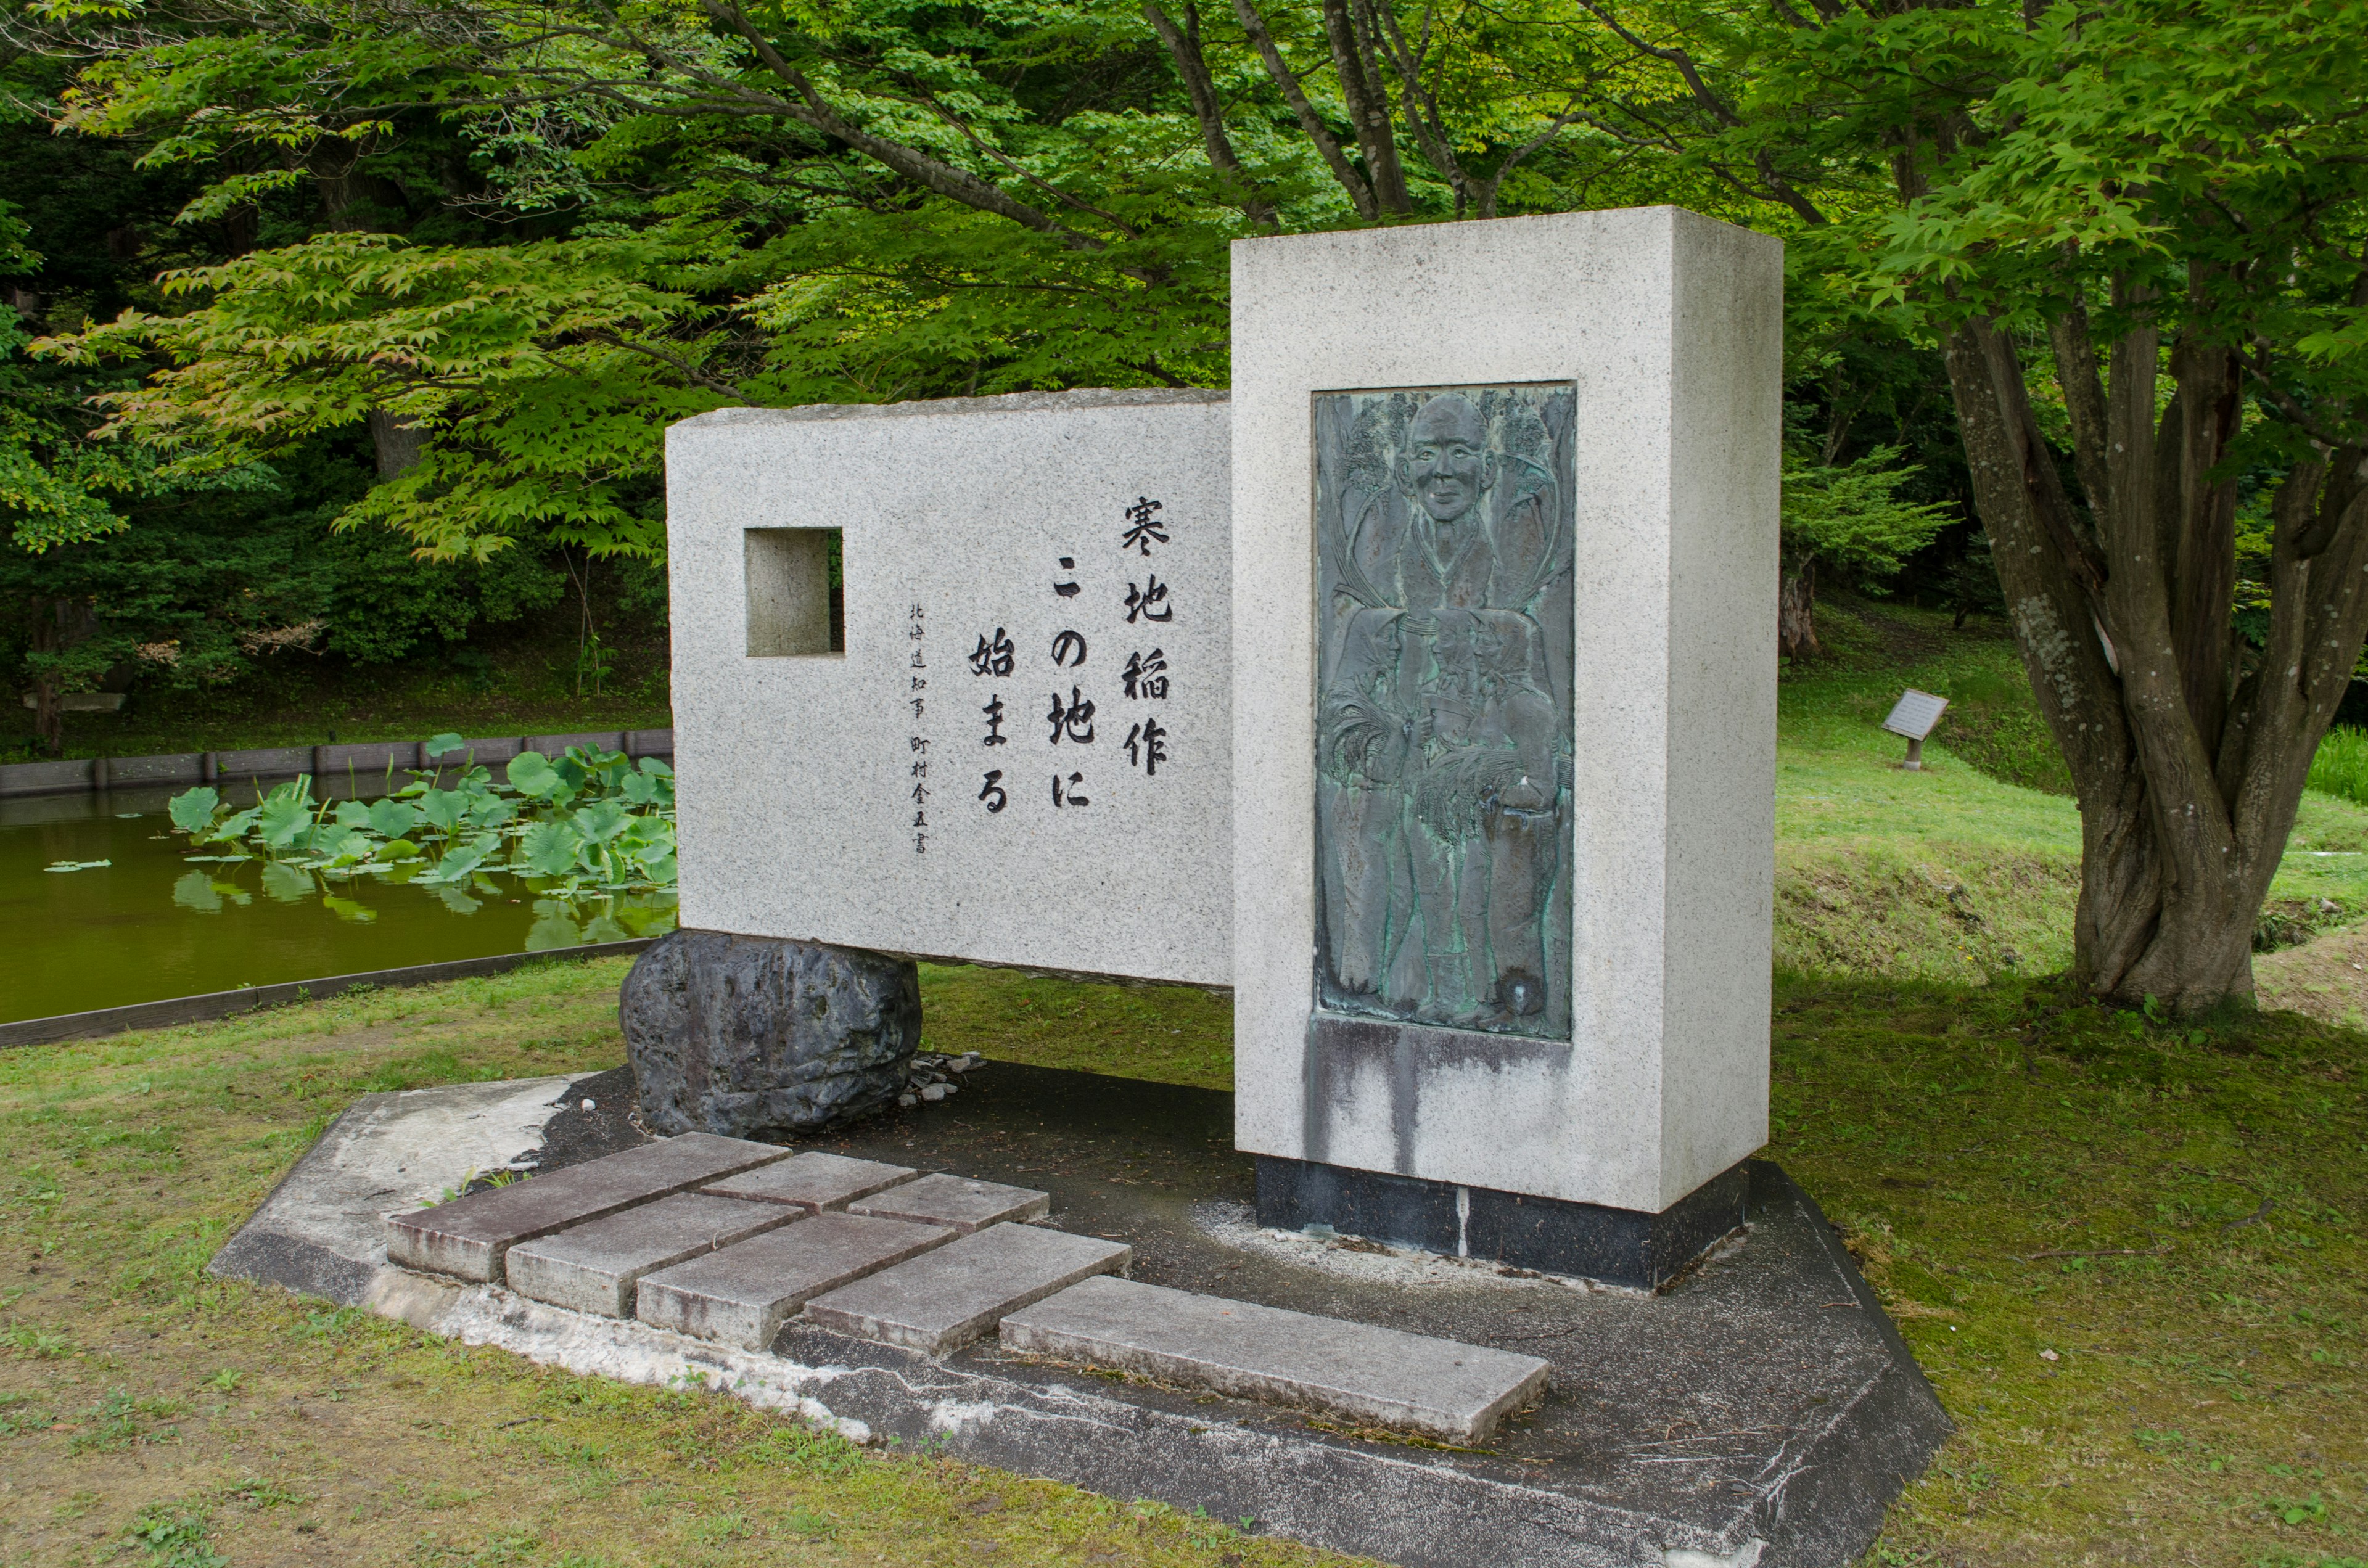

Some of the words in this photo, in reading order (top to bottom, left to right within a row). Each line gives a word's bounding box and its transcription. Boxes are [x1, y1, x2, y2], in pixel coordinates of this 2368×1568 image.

[910, 603, 927, 719] 北海道知事
[968, 626, 1015, 814] 始まる
[1049, 557, 1096, 808] この地に
[1121, 496, 1173, 776] 寒地稲作
[911, 736, 931, 855] 町村金五書
